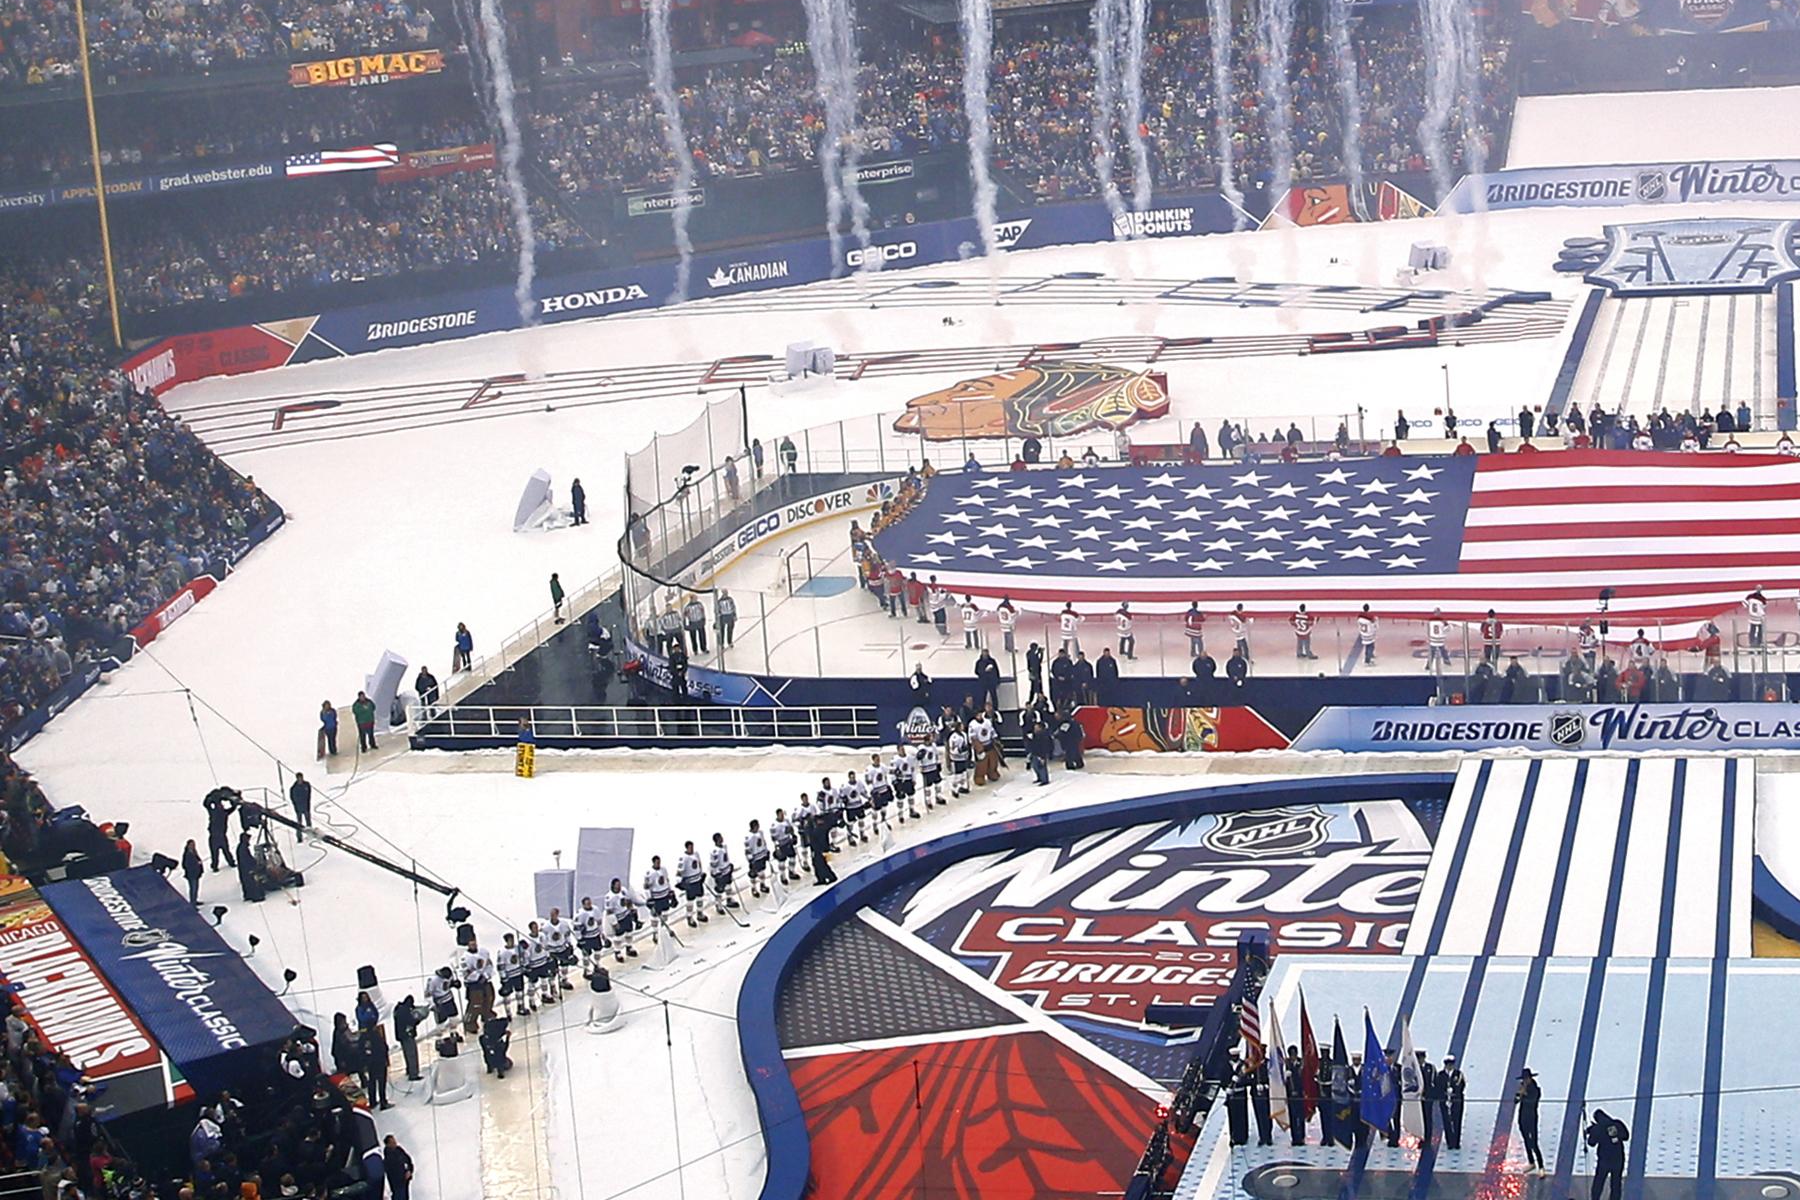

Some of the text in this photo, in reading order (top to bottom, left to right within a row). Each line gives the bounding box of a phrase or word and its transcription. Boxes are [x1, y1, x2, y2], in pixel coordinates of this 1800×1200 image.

[307, 52, 426, 85] BIG MAC
[349, 73, 389, 87] LAND
[62, 185, 101, 200] APPLY
[104, 180, 143, 195] TODAY
[160, 164, 273, 191] grad.webster.edu
[846, 164, 913, 181] nterprise
[1486, 179, 1632, 203] BRIDGESTONE
[1669, 162, 1790, 203] Winter
[1133, 207, 1194, 222] DUNKIN'
[1133, 217, 1193, 234] DONUTS
[846, 241, 917, 267] GEICO
[729, 260, 788, 284] CANADIAN
[541, 284, 648, 313] HONDA
[367, 310, 477, 340] BRIDGESTONE
[1492, 418, 1522, 427] GEIC
[737, 490, 852, 550] GEICO DISCOVER
[1295, 619, 1307, 631] 55
[688, 680, 723, 697] ASSIC
[896, 719, 942, 738] Winter
[1372, 719, 1542, 742] BRIDGESTONE
[1556, 720, 1582, 742] NHL
[1589, 704, 1732, 749] Winter
[1229, 816, 1310, 847] NHL
[900, 820, 1431, 932] Winte
[81, 875, 149, 931] BRIDGESTONE
[186, 995, 249, 1049] CLASSIC
[1154, 950, 1231, 964] 201
[1010, 960, 1234, 987] BRIDGES
[0, 932, 151, 1071] BLACKHAWKS
[1058, 993, 1137, 1007] ST.
